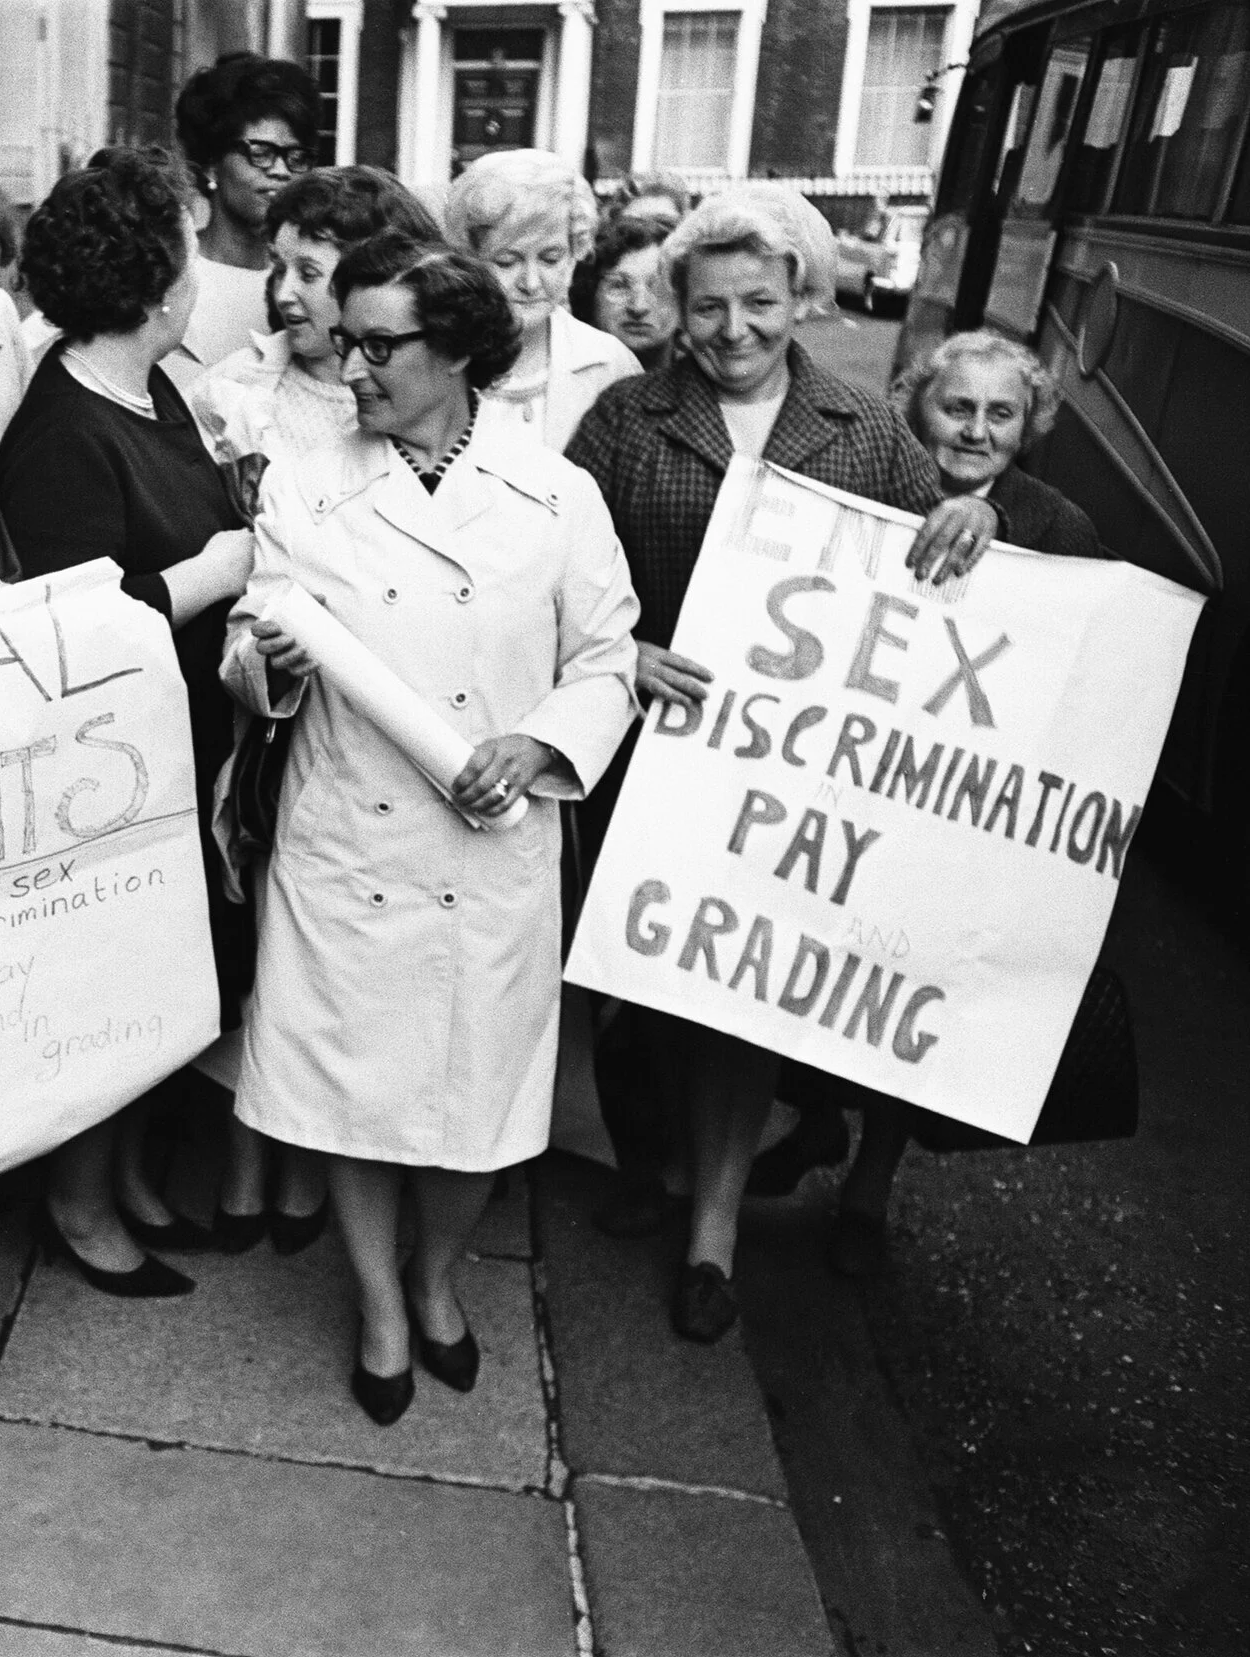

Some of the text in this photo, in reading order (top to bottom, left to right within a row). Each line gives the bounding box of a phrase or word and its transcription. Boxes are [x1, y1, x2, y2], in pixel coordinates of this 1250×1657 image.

[722, 458, 978, 605] EN
[745, 575, 1014, 729] SEX
[653, 689, 1143, 880] DISCRIMINATION
[727, 789, 882, 906] PAY
[10, 859, 75, 898] sex
[851, 917, 911, 959] AND
[625, 879, 947, 1064] GRADING
[36, 1015, 162, 1082] grading
